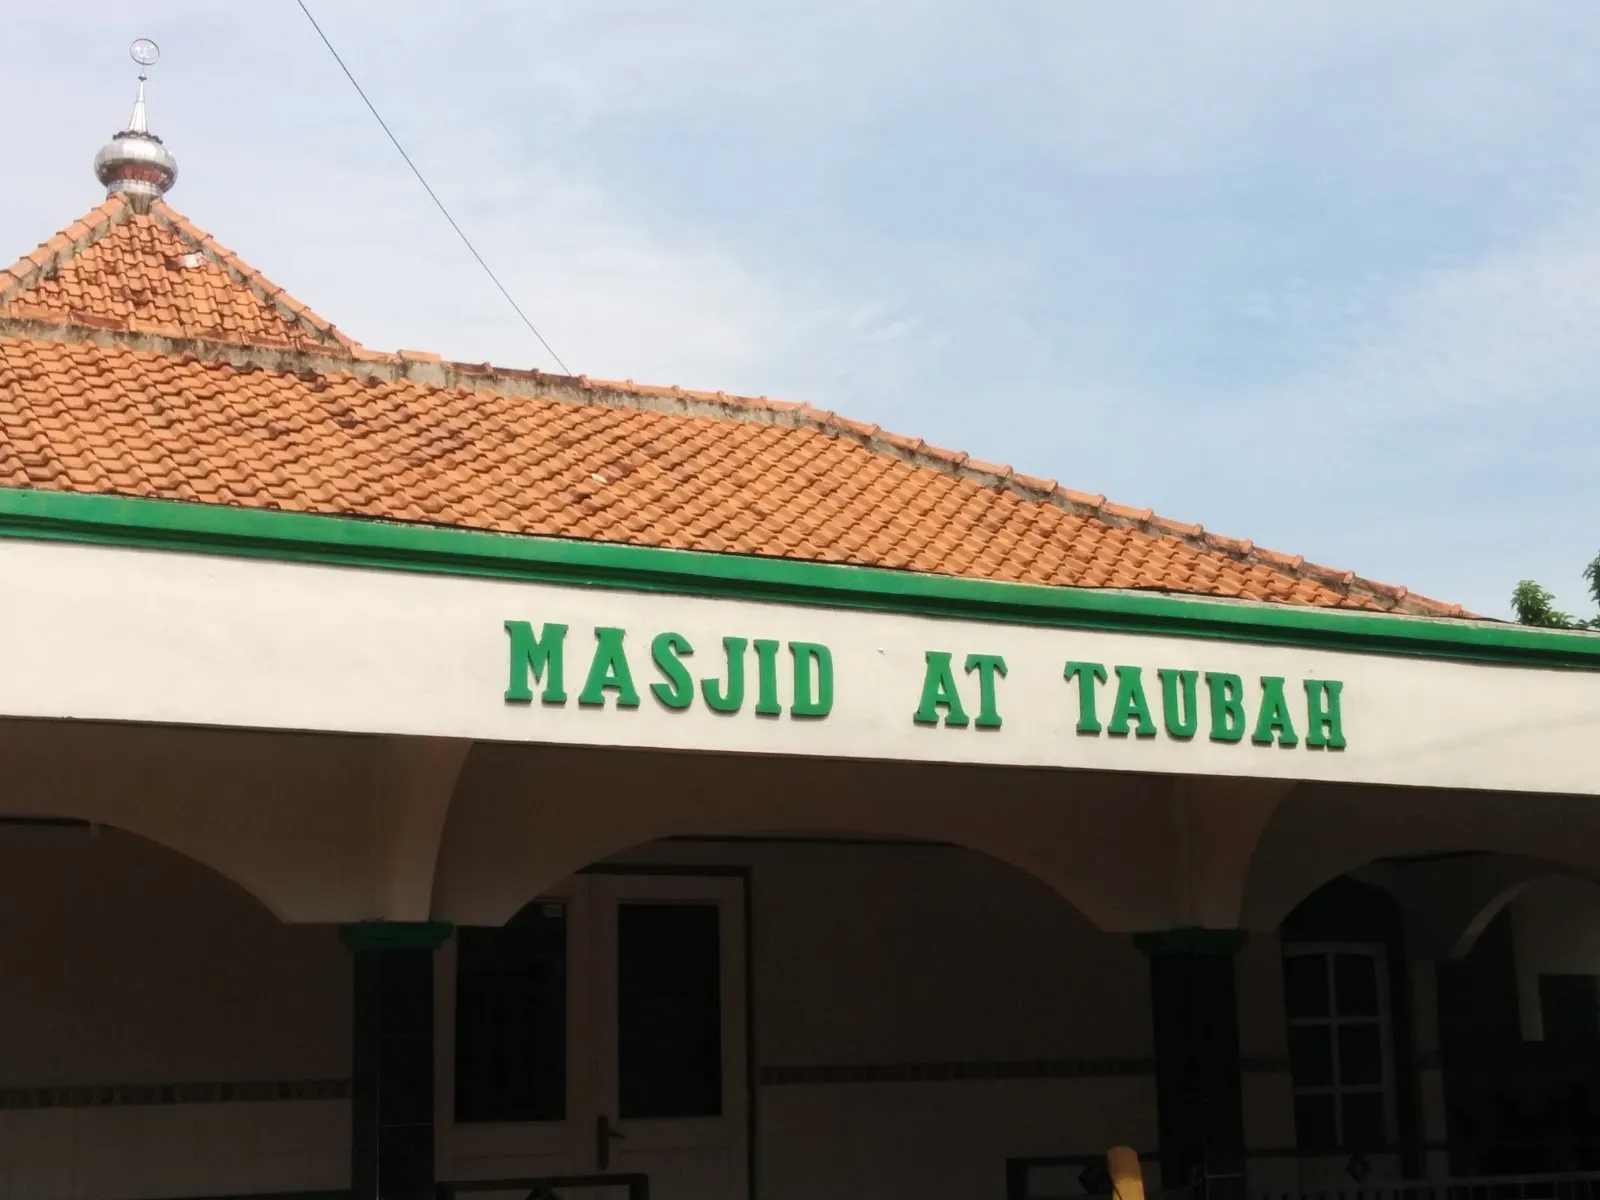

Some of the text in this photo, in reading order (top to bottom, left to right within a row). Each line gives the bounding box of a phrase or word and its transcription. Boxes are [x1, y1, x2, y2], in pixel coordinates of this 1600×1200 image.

[505, 620, 1347, 751] MASJID AT TAUBAH
